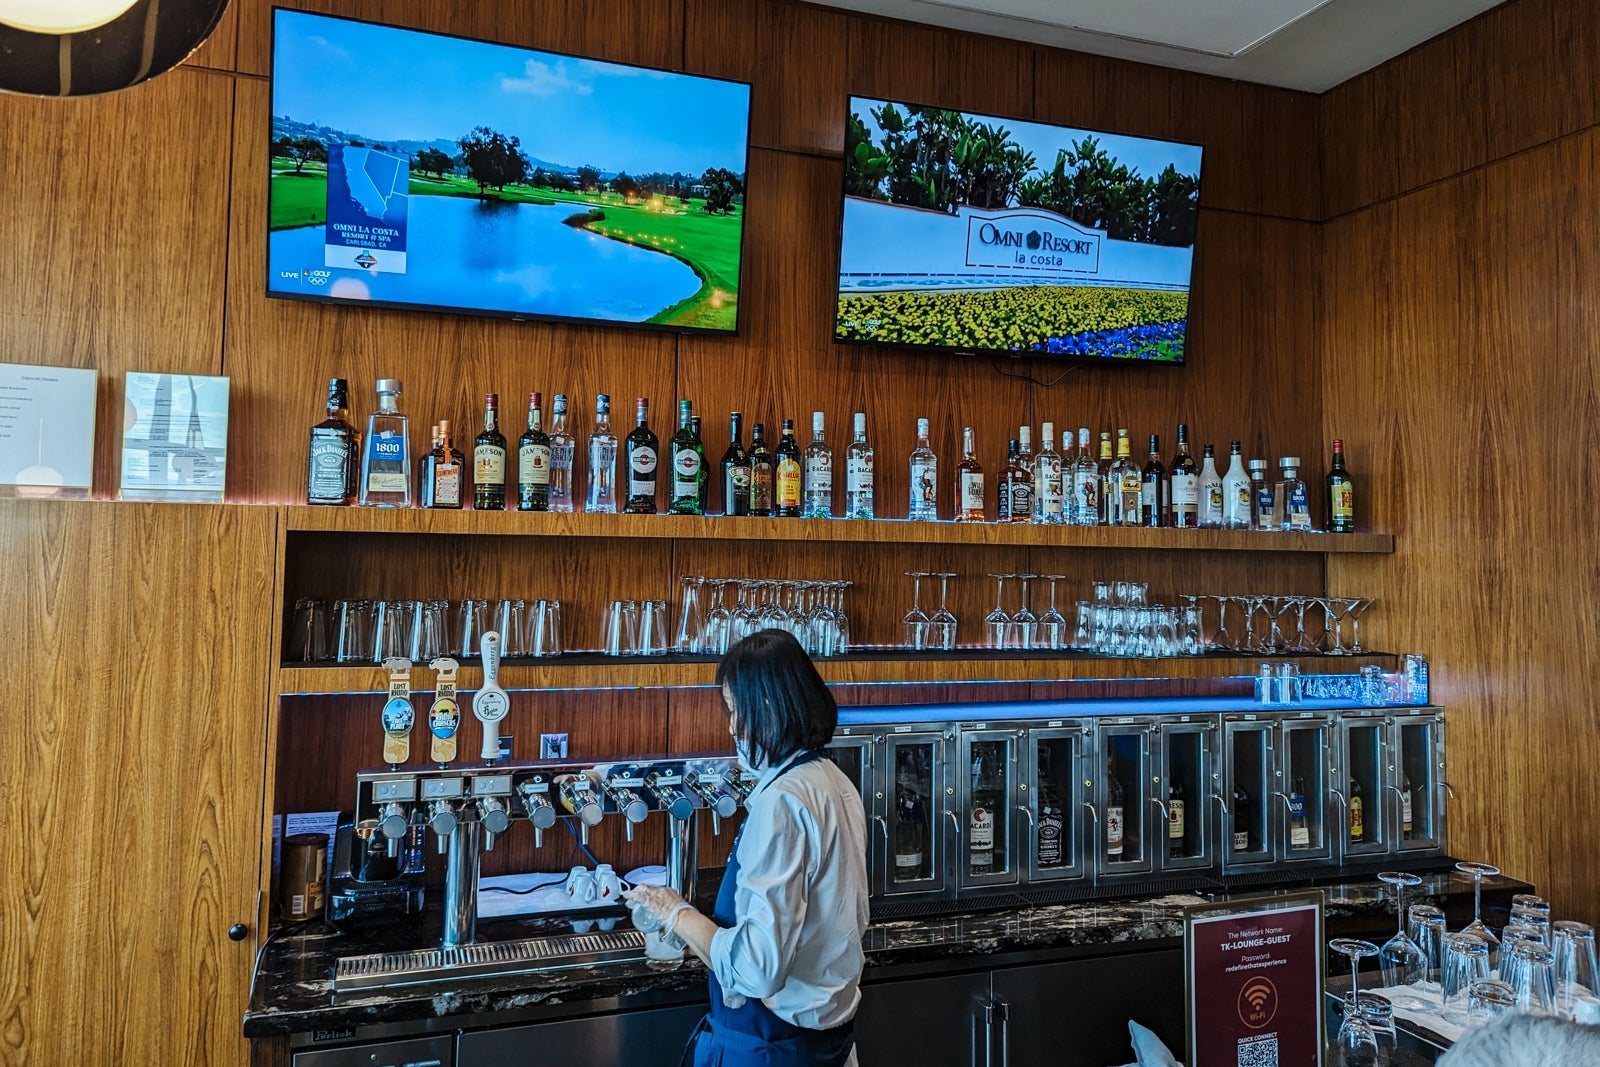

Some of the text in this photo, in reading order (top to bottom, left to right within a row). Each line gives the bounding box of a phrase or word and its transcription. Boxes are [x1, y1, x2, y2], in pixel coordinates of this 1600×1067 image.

[333, 223, 400, 237] OMNI LA COSTA
[341, 231, 369, 240] RESORT
[980, 223, 1093, 255] OMNI RESORT
[1015, 250, 1063, 266] la costa
[313, 270, 332, 278] GOLF
[376, 443, 400, 453] 1800
[391, 689, 408, 697] RHINO
[437, 690, 455, 698] RHINO
[1240, 929, 1265, 938] Network
[1220, 934, 1291, 952] TK-LOUNGE-GUEST
[1225, 958, 1287, 973] redefinethatexperience
[1250, 1011, 1266, 1021] Wi-Fi
[1237, 1031, 1278, 1044] QUICK CONNECT
